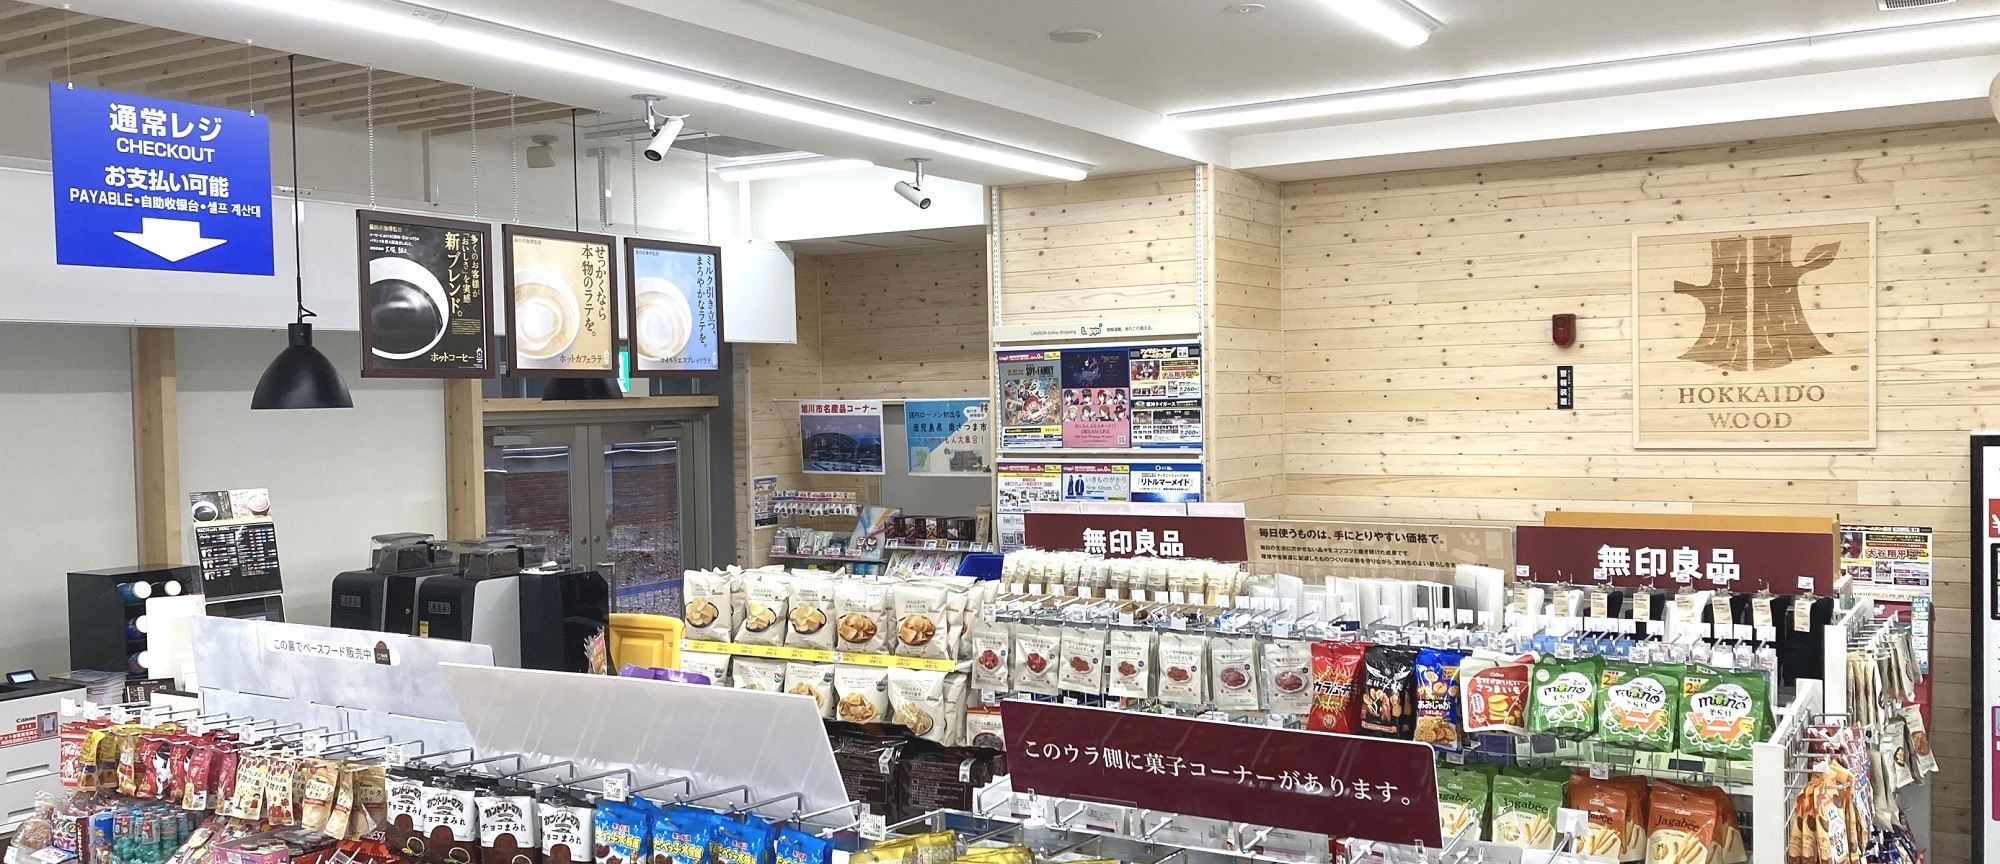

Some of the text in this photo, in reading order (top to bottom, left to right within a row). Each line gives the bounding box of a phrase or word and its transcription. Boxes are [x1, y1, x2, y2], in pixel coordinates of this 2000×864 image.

[109, 102, 222, 142] 通常レジ
[116, 137, 215, 162] CHECKOUT
[104, 165, 229, 198] お支払い可能
[230, 203, 261, 218] 계산대
[444, 231, 463, 317] 新ブレンド。
[470, 234, 480, 298] 多くのお客様が
[582, 244, 596, 337] 本物のラテを。
[594, 246, 607, 320] せっかくなら
[696, 255, 708, 348] まろやかなラテを。
[430, 352, 475, 362] ホットコーヒー
[560, 354, 603, 364] ホットカフェラテ
[1678, 386, 1825, 404] HOKKAIDO
[801, 404, 878, 414] 旭川市名産品コーナー
[912, 422, 987, 432] 鹿児島県 南さつま市
[1707, 412, 1792, 429] WOOD
[1082, 528, 1184, 558] 無印良品
[1259, 528, 1444, 544] 毎日使うものは、手にとりやすい価格で。
[1598, 544, 1740, 581] 無印良品
[274, 640, 371, 660] この裏でベースフード販売中
[1476, 685, 1520, 694] さつまいも
[1418, 700, 1451, 710] あみじゃが
[1024, 740, 1411, 806] このウラ側に菓子コーナーがあります。
[427, 796, 464, 813] カントリーマアム
[484, 803, 522, 819] カントリーマアム
[1504, 797, 1549, 813] Jagabee
[423, 814, 466, 826] チョコまみれ
[482, 824, 526, 832] チョコまみれ
[544, 813, 580, 832] カントリーマアム
[1655, 815, 1700, 832] Jagabee
